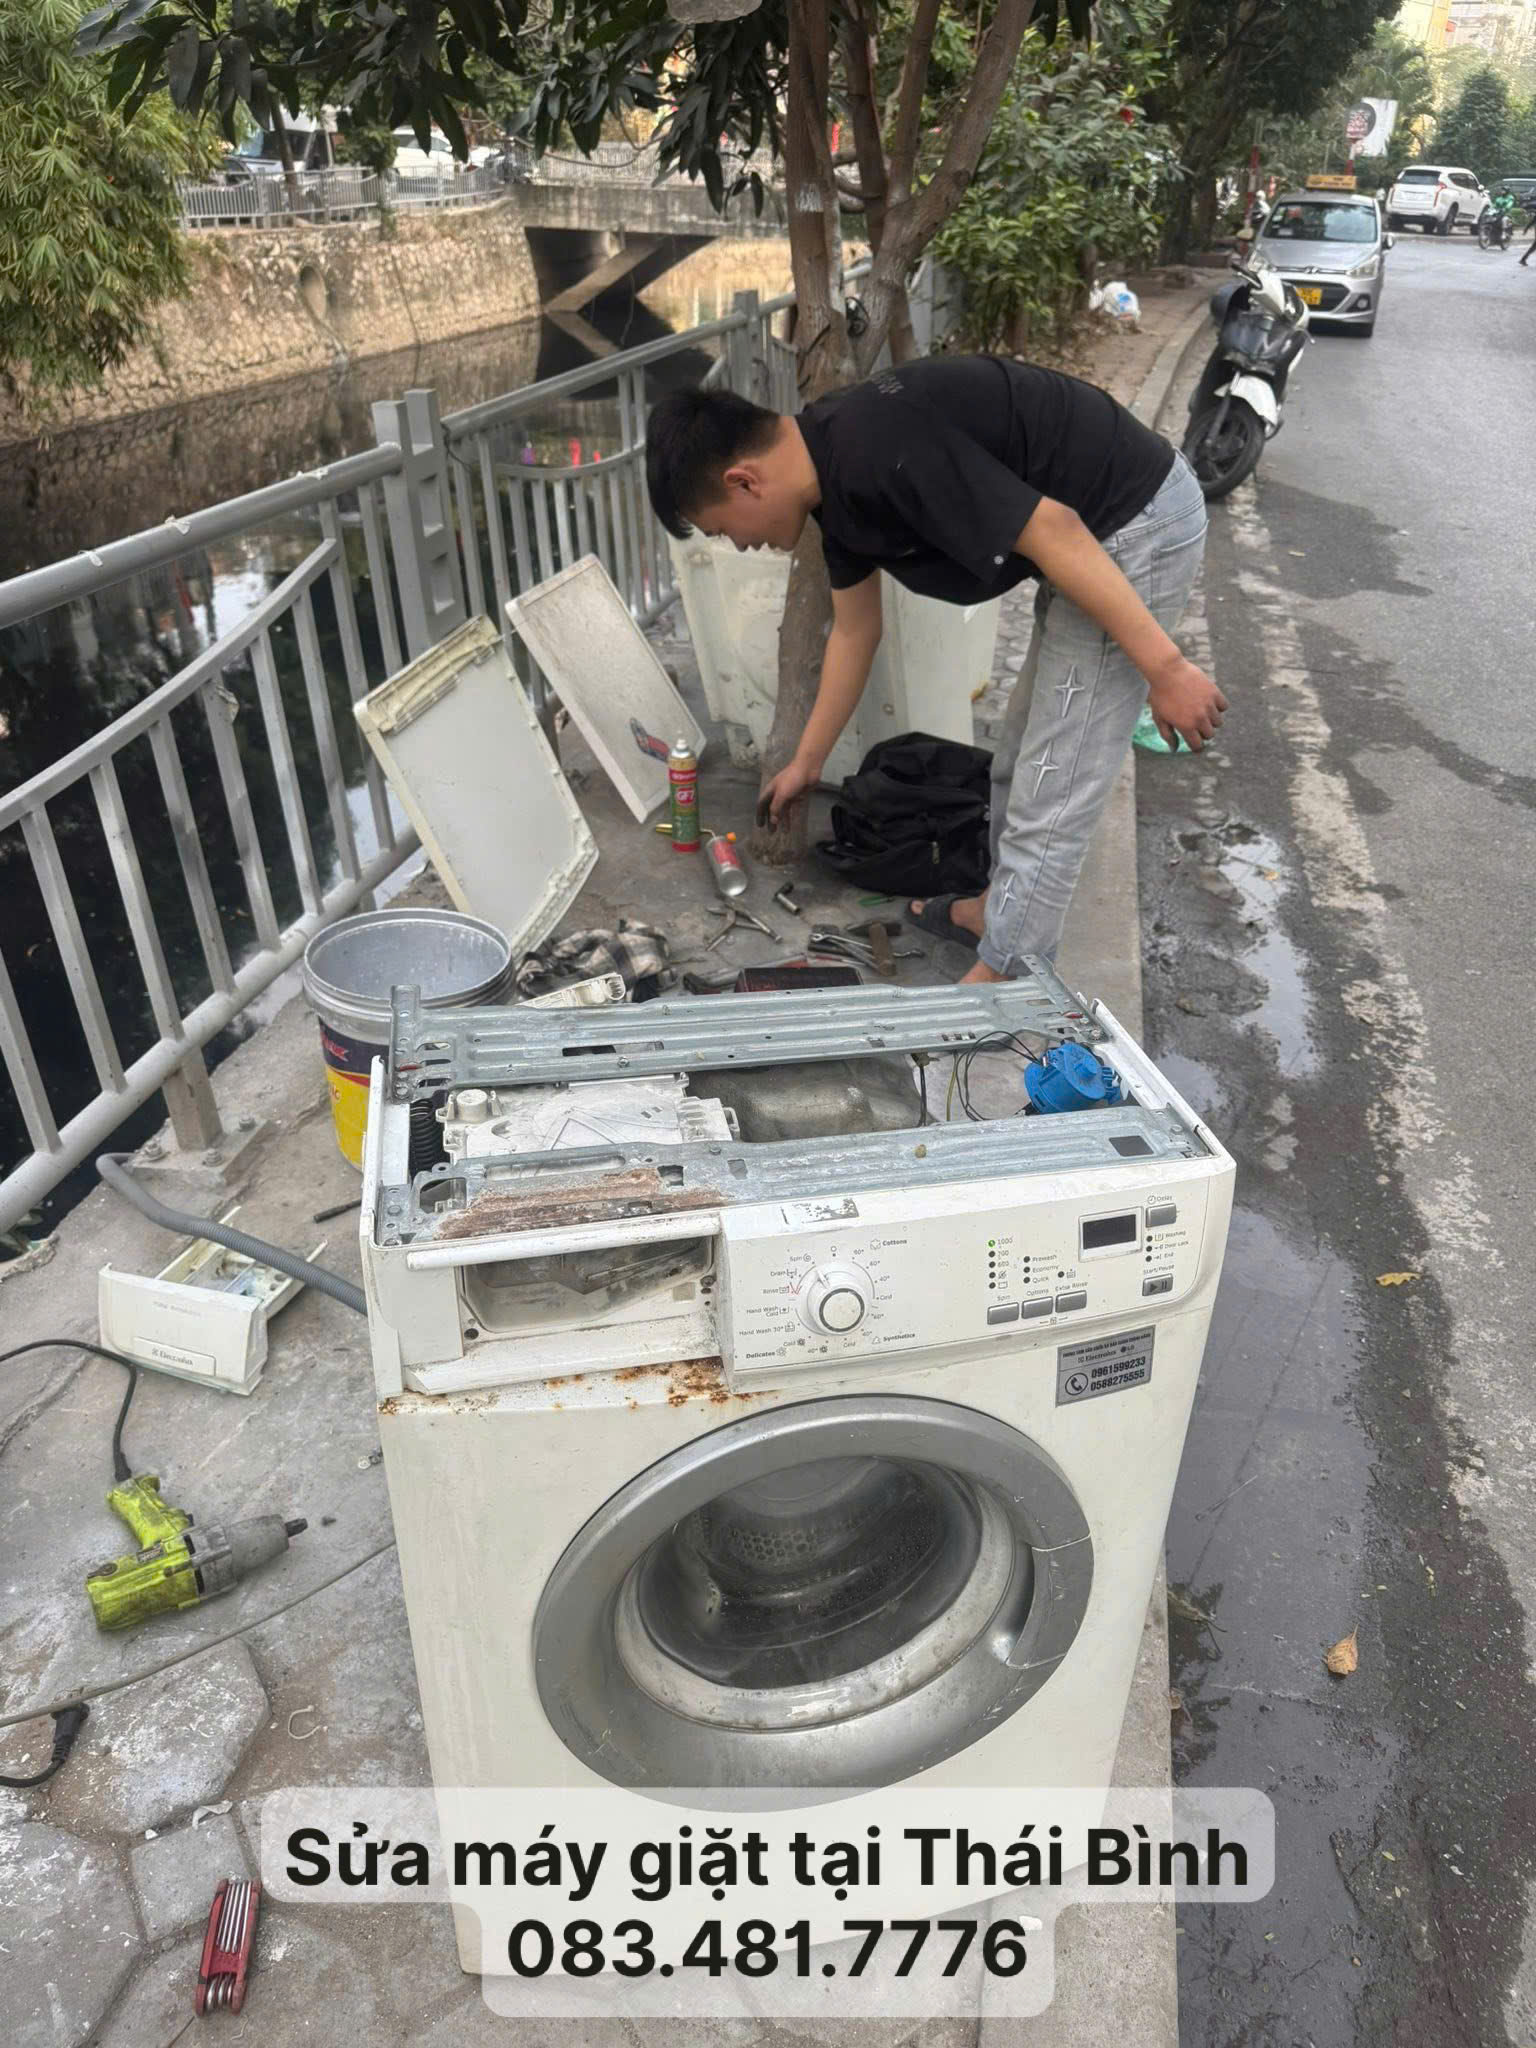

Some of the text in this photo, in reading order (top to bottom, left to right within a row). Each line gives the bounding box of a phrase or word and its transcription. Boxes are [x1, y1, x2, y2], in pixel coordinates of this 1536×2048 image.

[882, 1239, 908, 1247] Cottons
[1032, 1264, 1059, 1273] Economy
[1032, 1276, 1049, 1284] Quick
[1026, 1288, 1049, 1297] Options
[745, 1350, 776, 1360] Delicates
[1091, 1356, 1146, 1378] 0961599233
[1090, 1368, 1145, 1391] 0588275555
